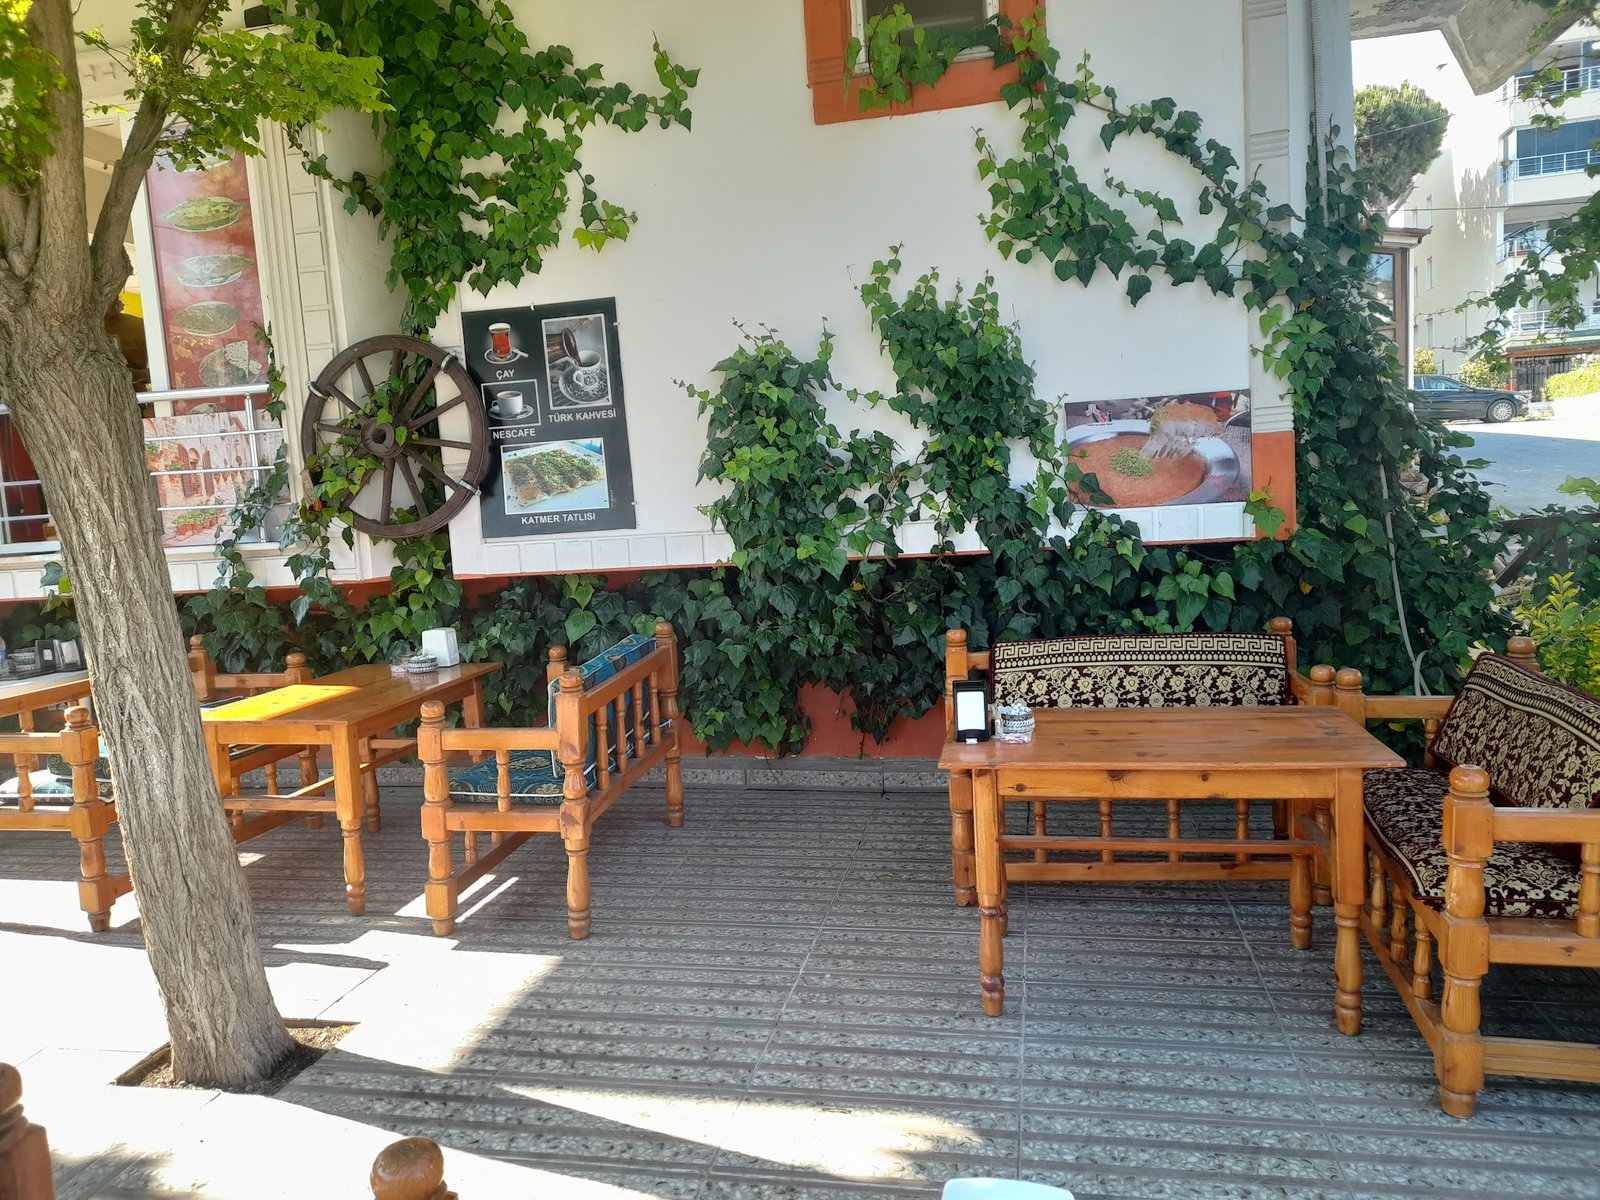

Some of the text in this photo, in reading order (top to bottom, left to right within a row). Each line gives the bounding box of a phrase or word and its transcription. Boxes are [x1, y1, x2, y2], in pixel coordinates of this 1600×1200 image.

[496, 369, 515, 380] ÇAY
[548, 408, 617, 423] TÜRK KAHVESİ
[492, 428, 536, 439] NESCAFE
[521, 512, 596, 525] KATMER TATLISI
